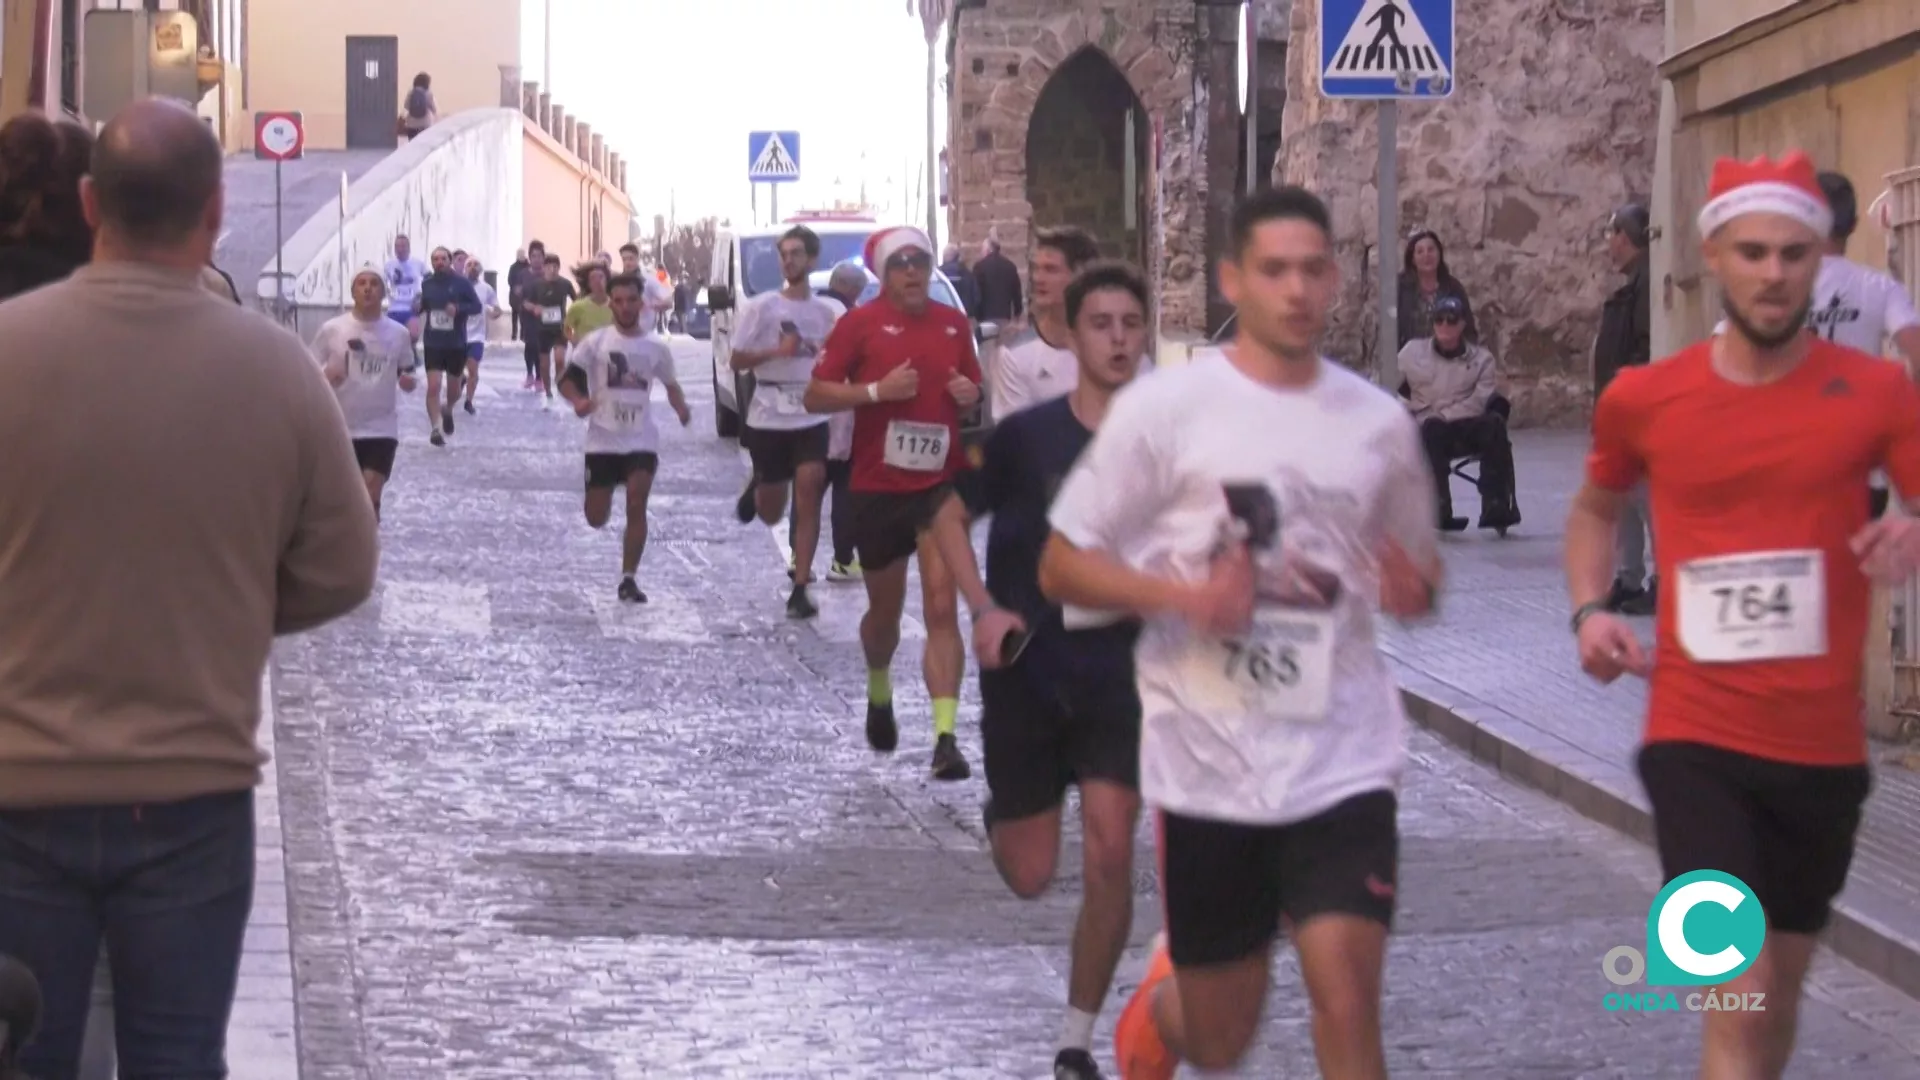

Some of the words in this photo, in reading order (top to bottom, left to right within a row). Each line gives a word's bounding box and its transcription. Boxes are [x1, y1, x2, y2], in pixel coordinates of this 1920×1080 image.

[896, 434, 942, 455] 1178
[1711, 583, 1793, 622] 764
[1220, 639, 1302, 691] 765
